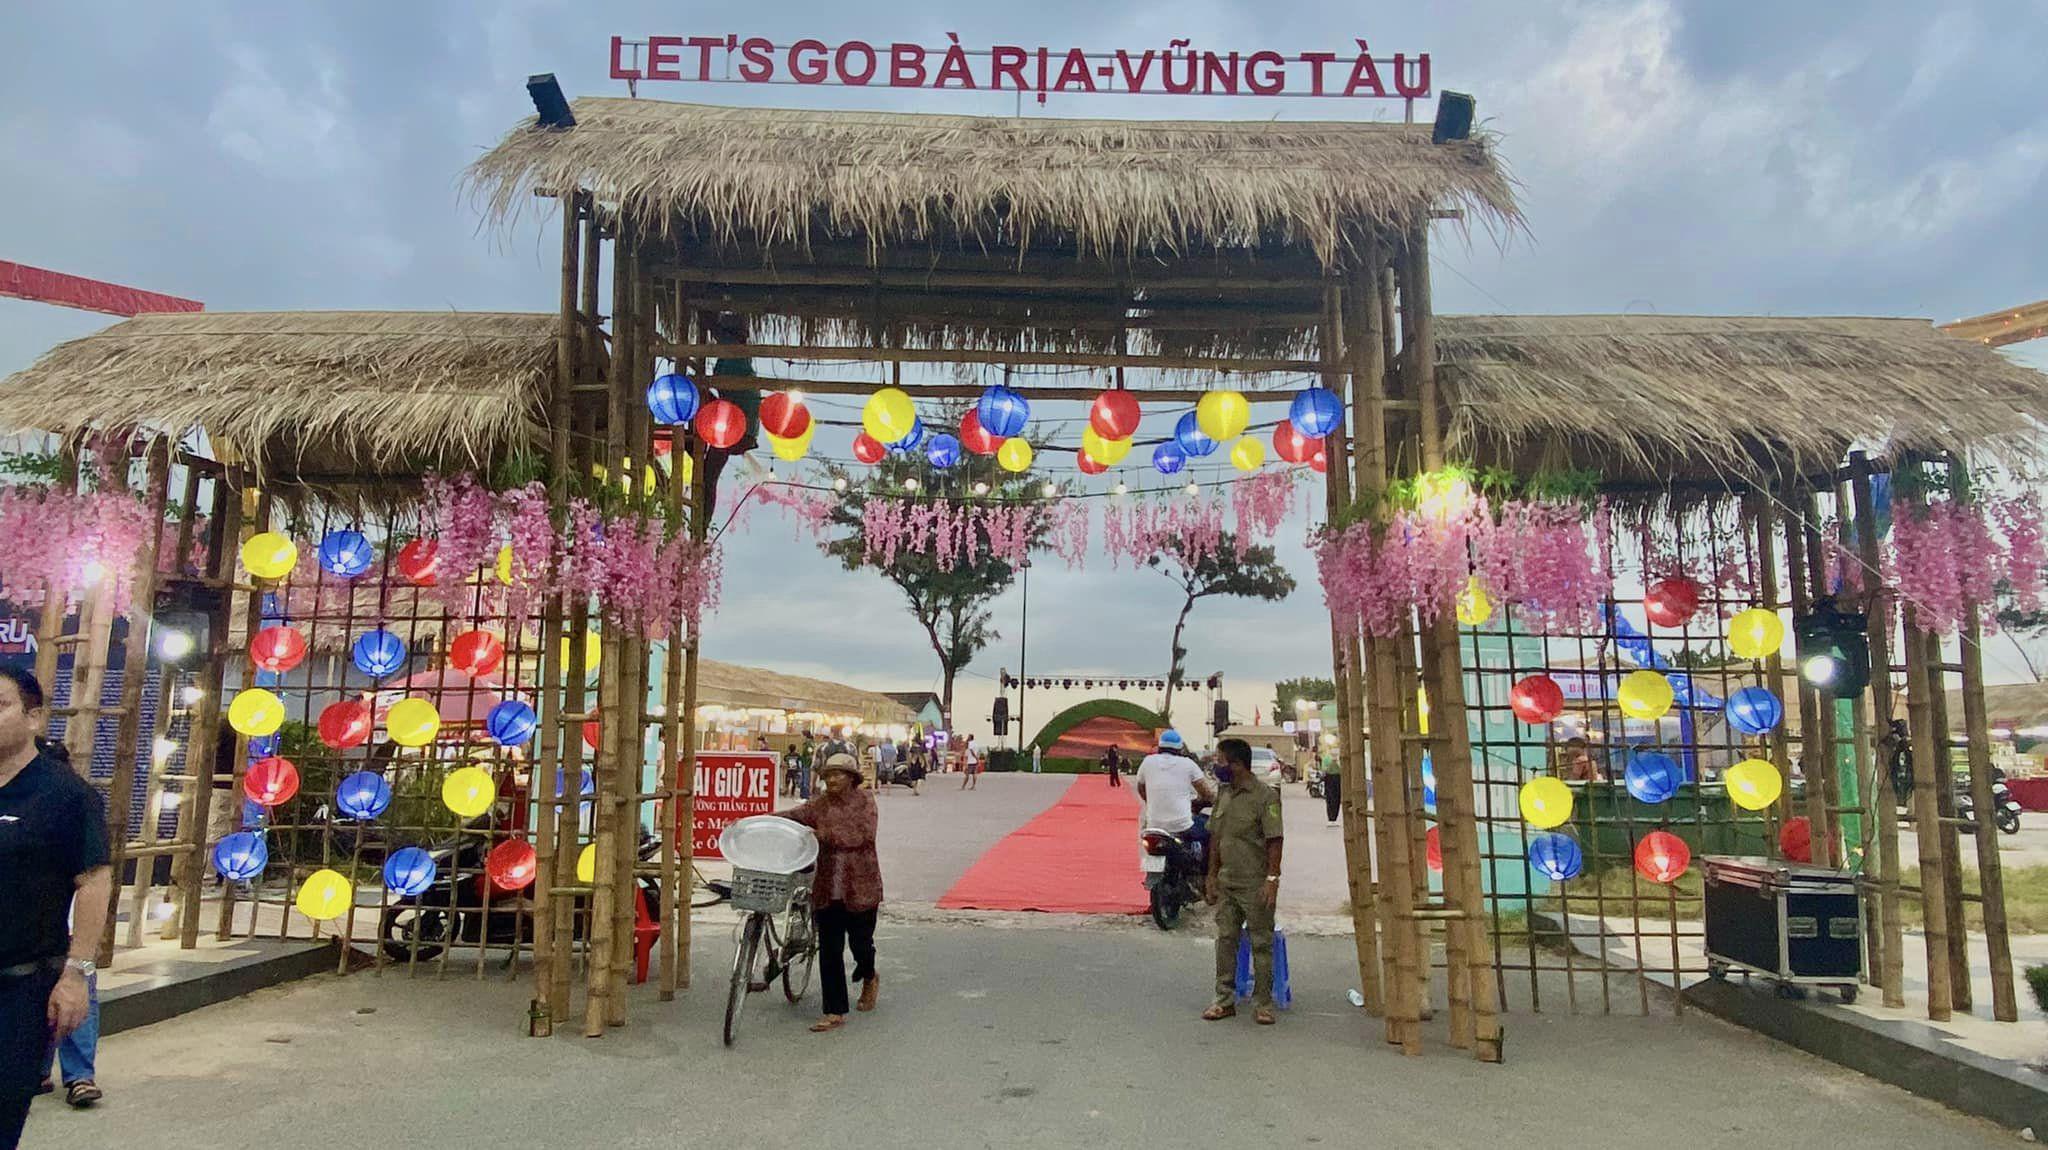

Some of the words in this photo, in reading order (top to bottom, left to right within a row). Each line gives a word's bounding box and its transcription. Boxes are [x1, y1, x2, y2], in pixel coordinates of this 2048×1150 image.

[609, 33, 775, 83] LET'S
[788, 38, 878, 87] GO
[889, 31, 977, 90] BÀ
[1300, 38, 1431, 99] TÀU
[693, 761, 711, 797] ÃI
[715, 761, 746, 799] GIỮ
[747, 767, 770, 798] XE
